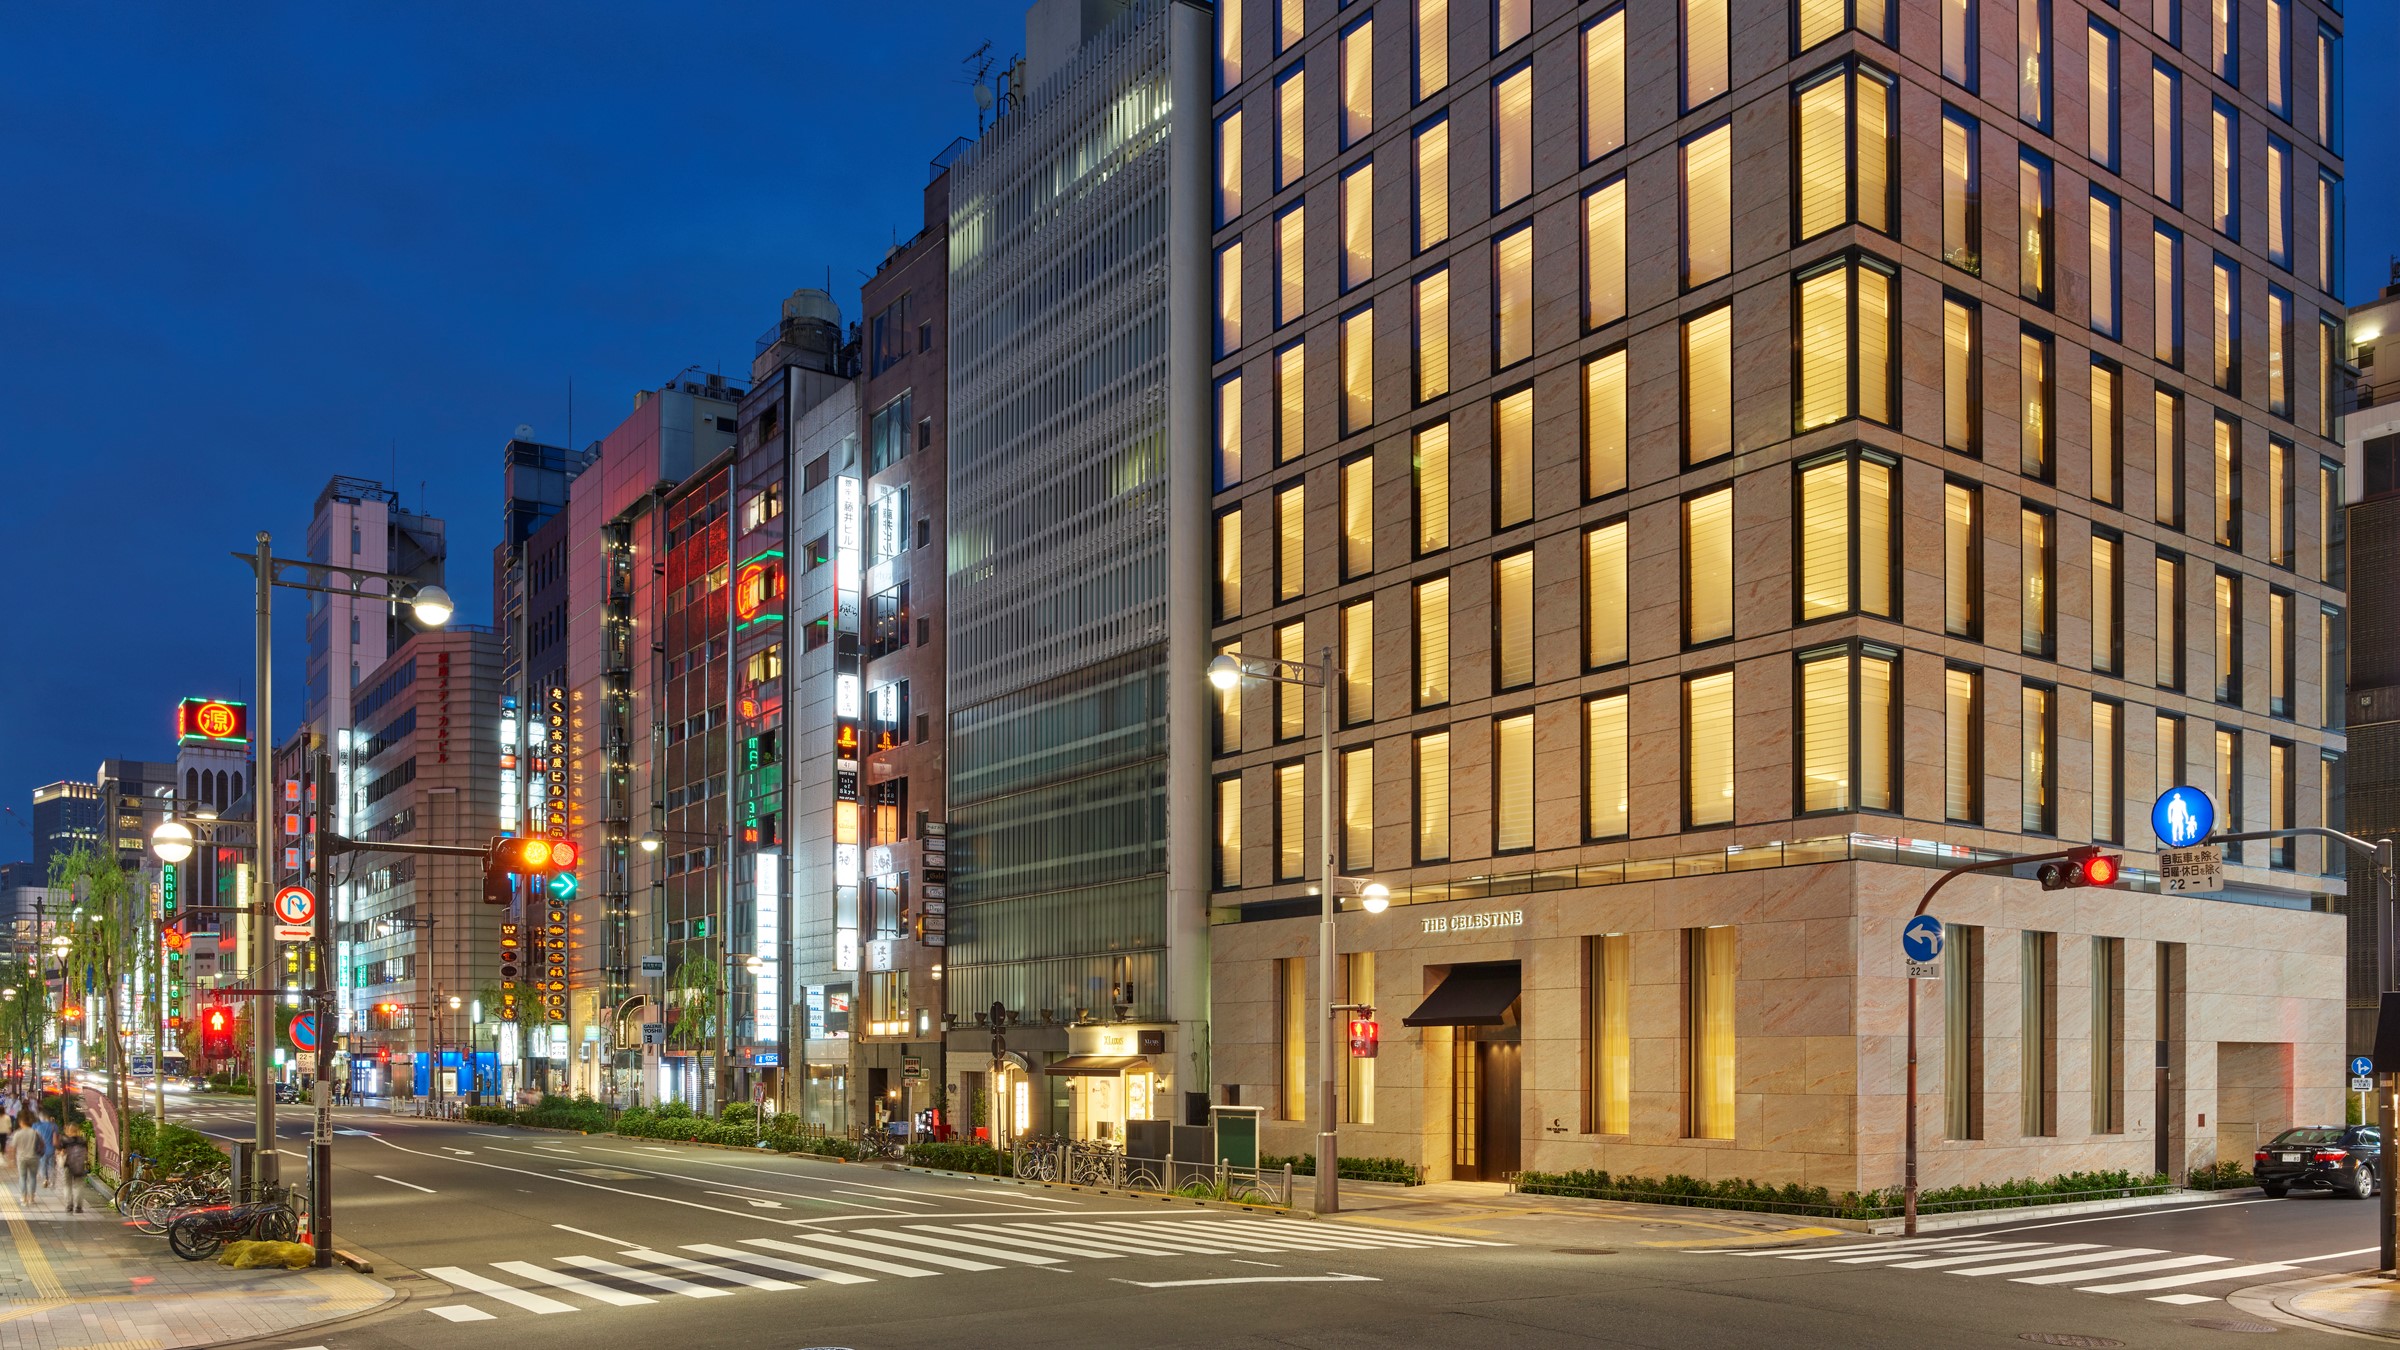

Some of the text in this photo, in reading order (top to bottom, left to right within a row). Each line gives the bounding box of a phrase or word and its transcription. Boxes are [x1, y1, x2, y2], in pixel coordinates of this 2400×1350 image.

[202, 708, 230, 733] 源
[551, 688, 563, 792] たくみ高木屋ビル
[2162, 851, 2220, 865] 自転車を除く
[2162, 864, 2220, 878] 日曜・休日を除く
[165, 864, 174, 918] MARUGE
[1420, 910, 1523, 933] THE CELESTINE
